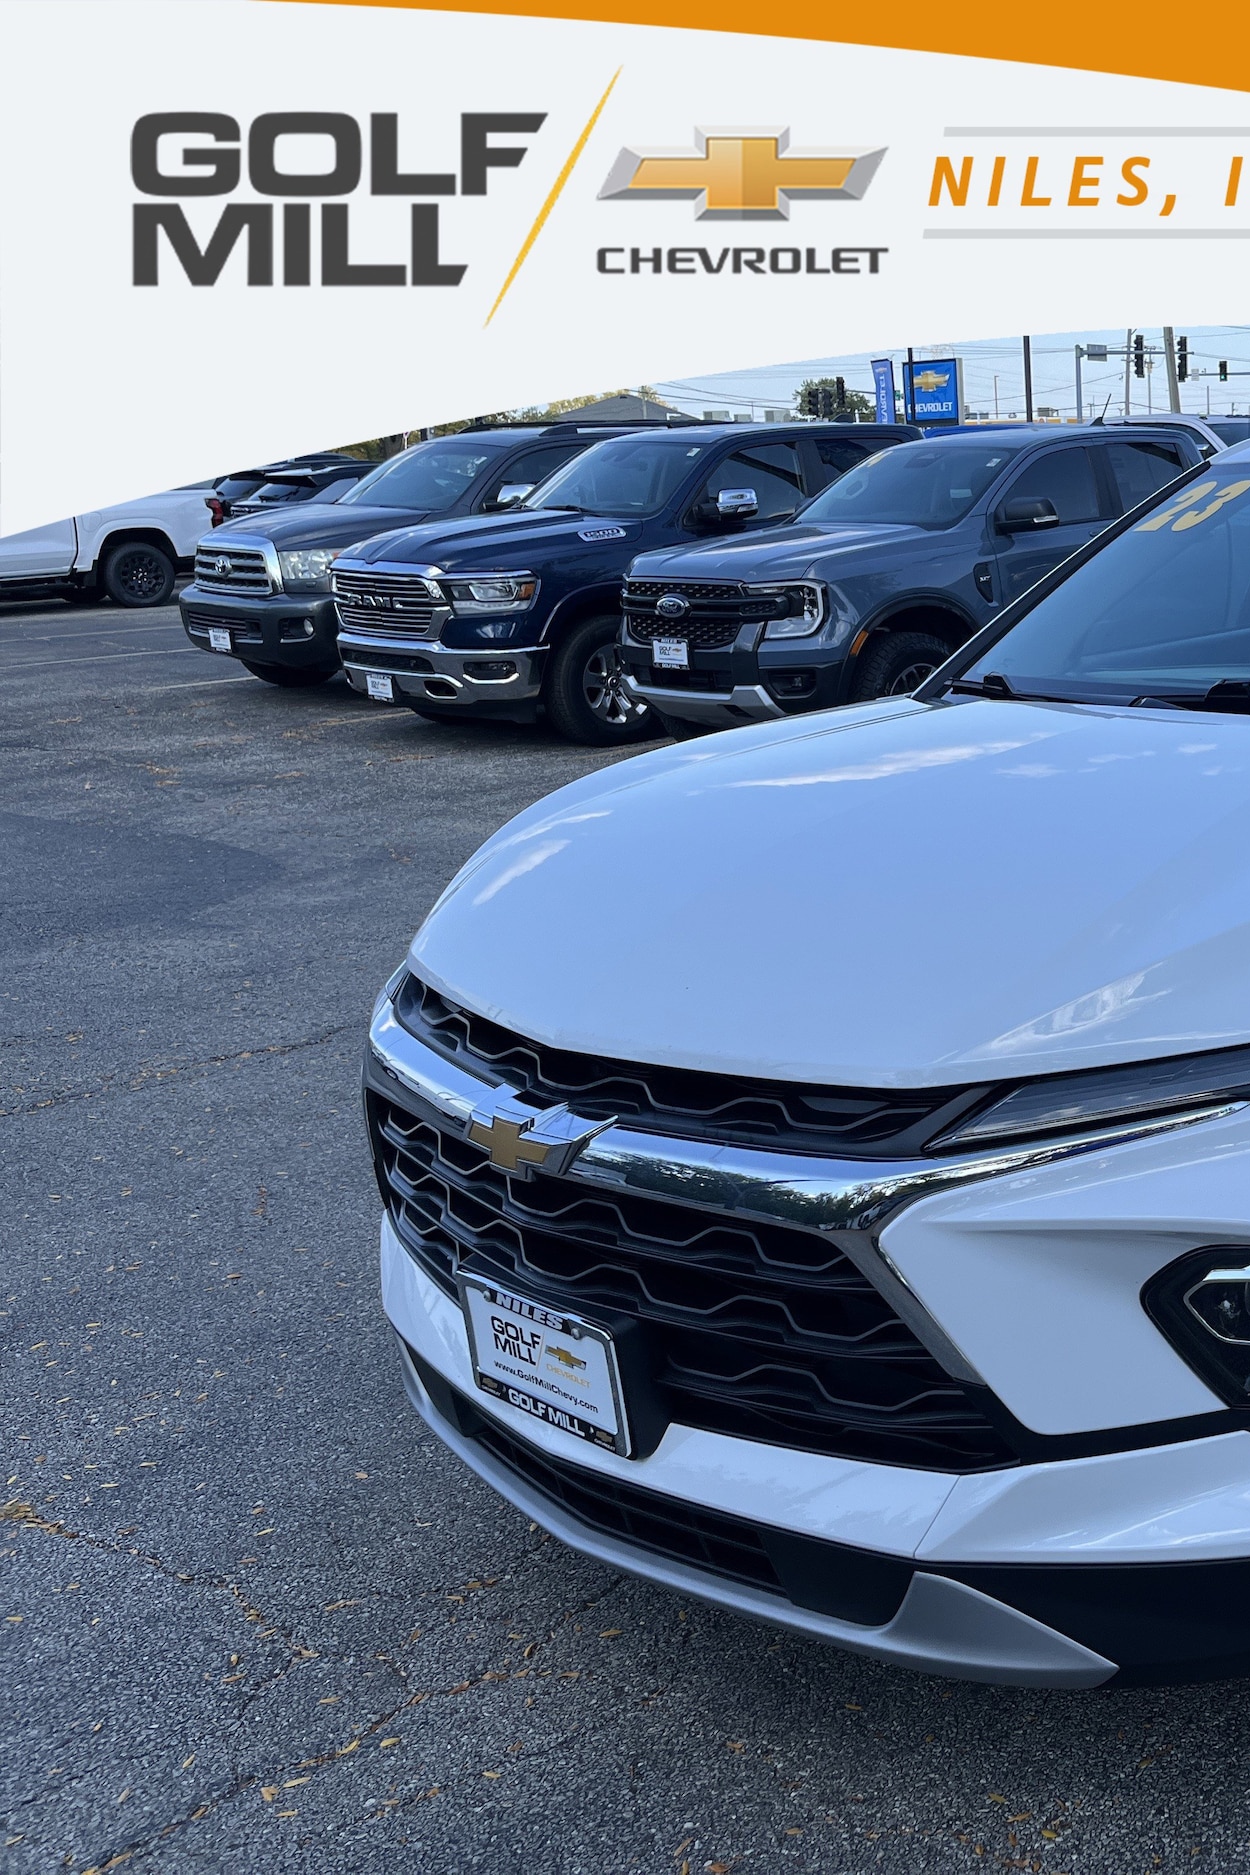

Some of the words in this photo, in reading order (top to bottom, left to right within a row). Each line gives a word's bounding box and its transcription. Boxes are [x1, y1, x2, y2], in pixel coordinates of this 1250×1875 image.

[495, 1292, 564, 1330] NILES
[490, 1315, 541, 1347] GOLF
[493, 1333, 537, 1366] MILL
[493, 1360, 599, 1414] www.GolfMillChevy.com
[546, 1363, 591, 1389] CHEVROLET
[508, 1388, 546, 1417] GOLF
[549, 1406, 586, 1437] MILL
